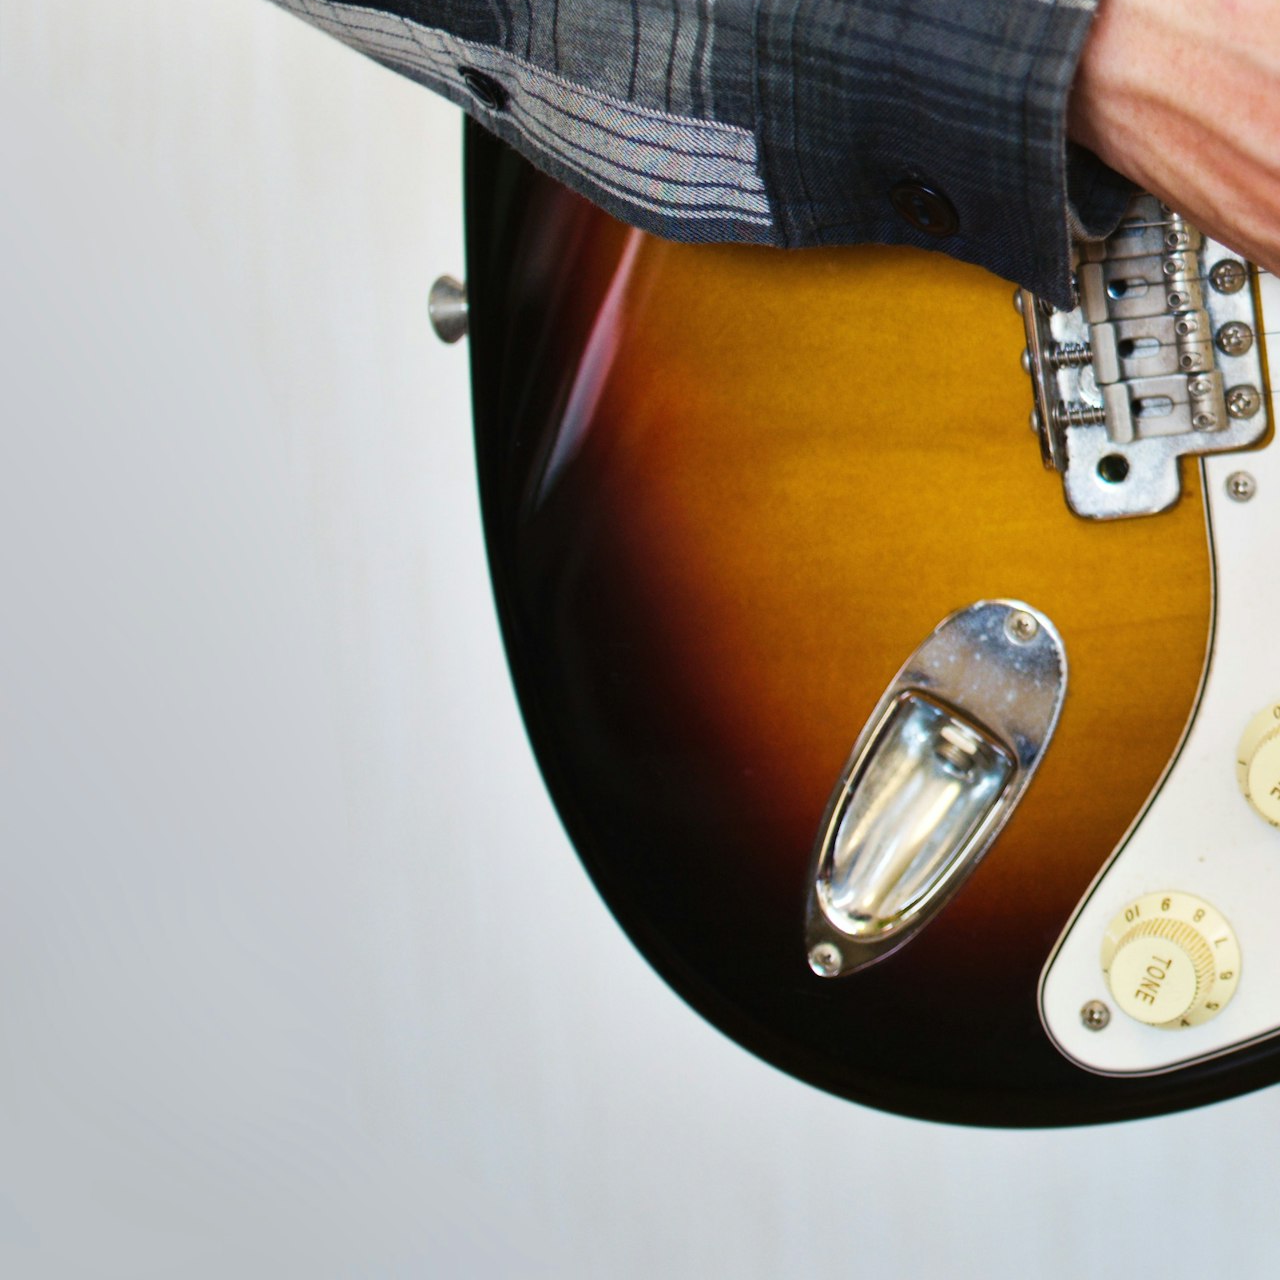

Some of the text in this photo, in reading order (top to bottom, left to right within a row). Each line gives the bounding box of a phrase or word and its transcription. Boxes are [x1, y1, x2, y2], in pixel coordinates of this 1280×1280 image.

[1161, 898, 1171, 911] 9
[1125, 905, 1140, 922] 10
[1194, 909, 1206, 922] 8
[1214, 937, 1227, 948] 7
[1135, 955, 1172, 1006] TONE
[1220, 971, 1233, 980] 6
[1206, 1001, 1219, 1011] 5
